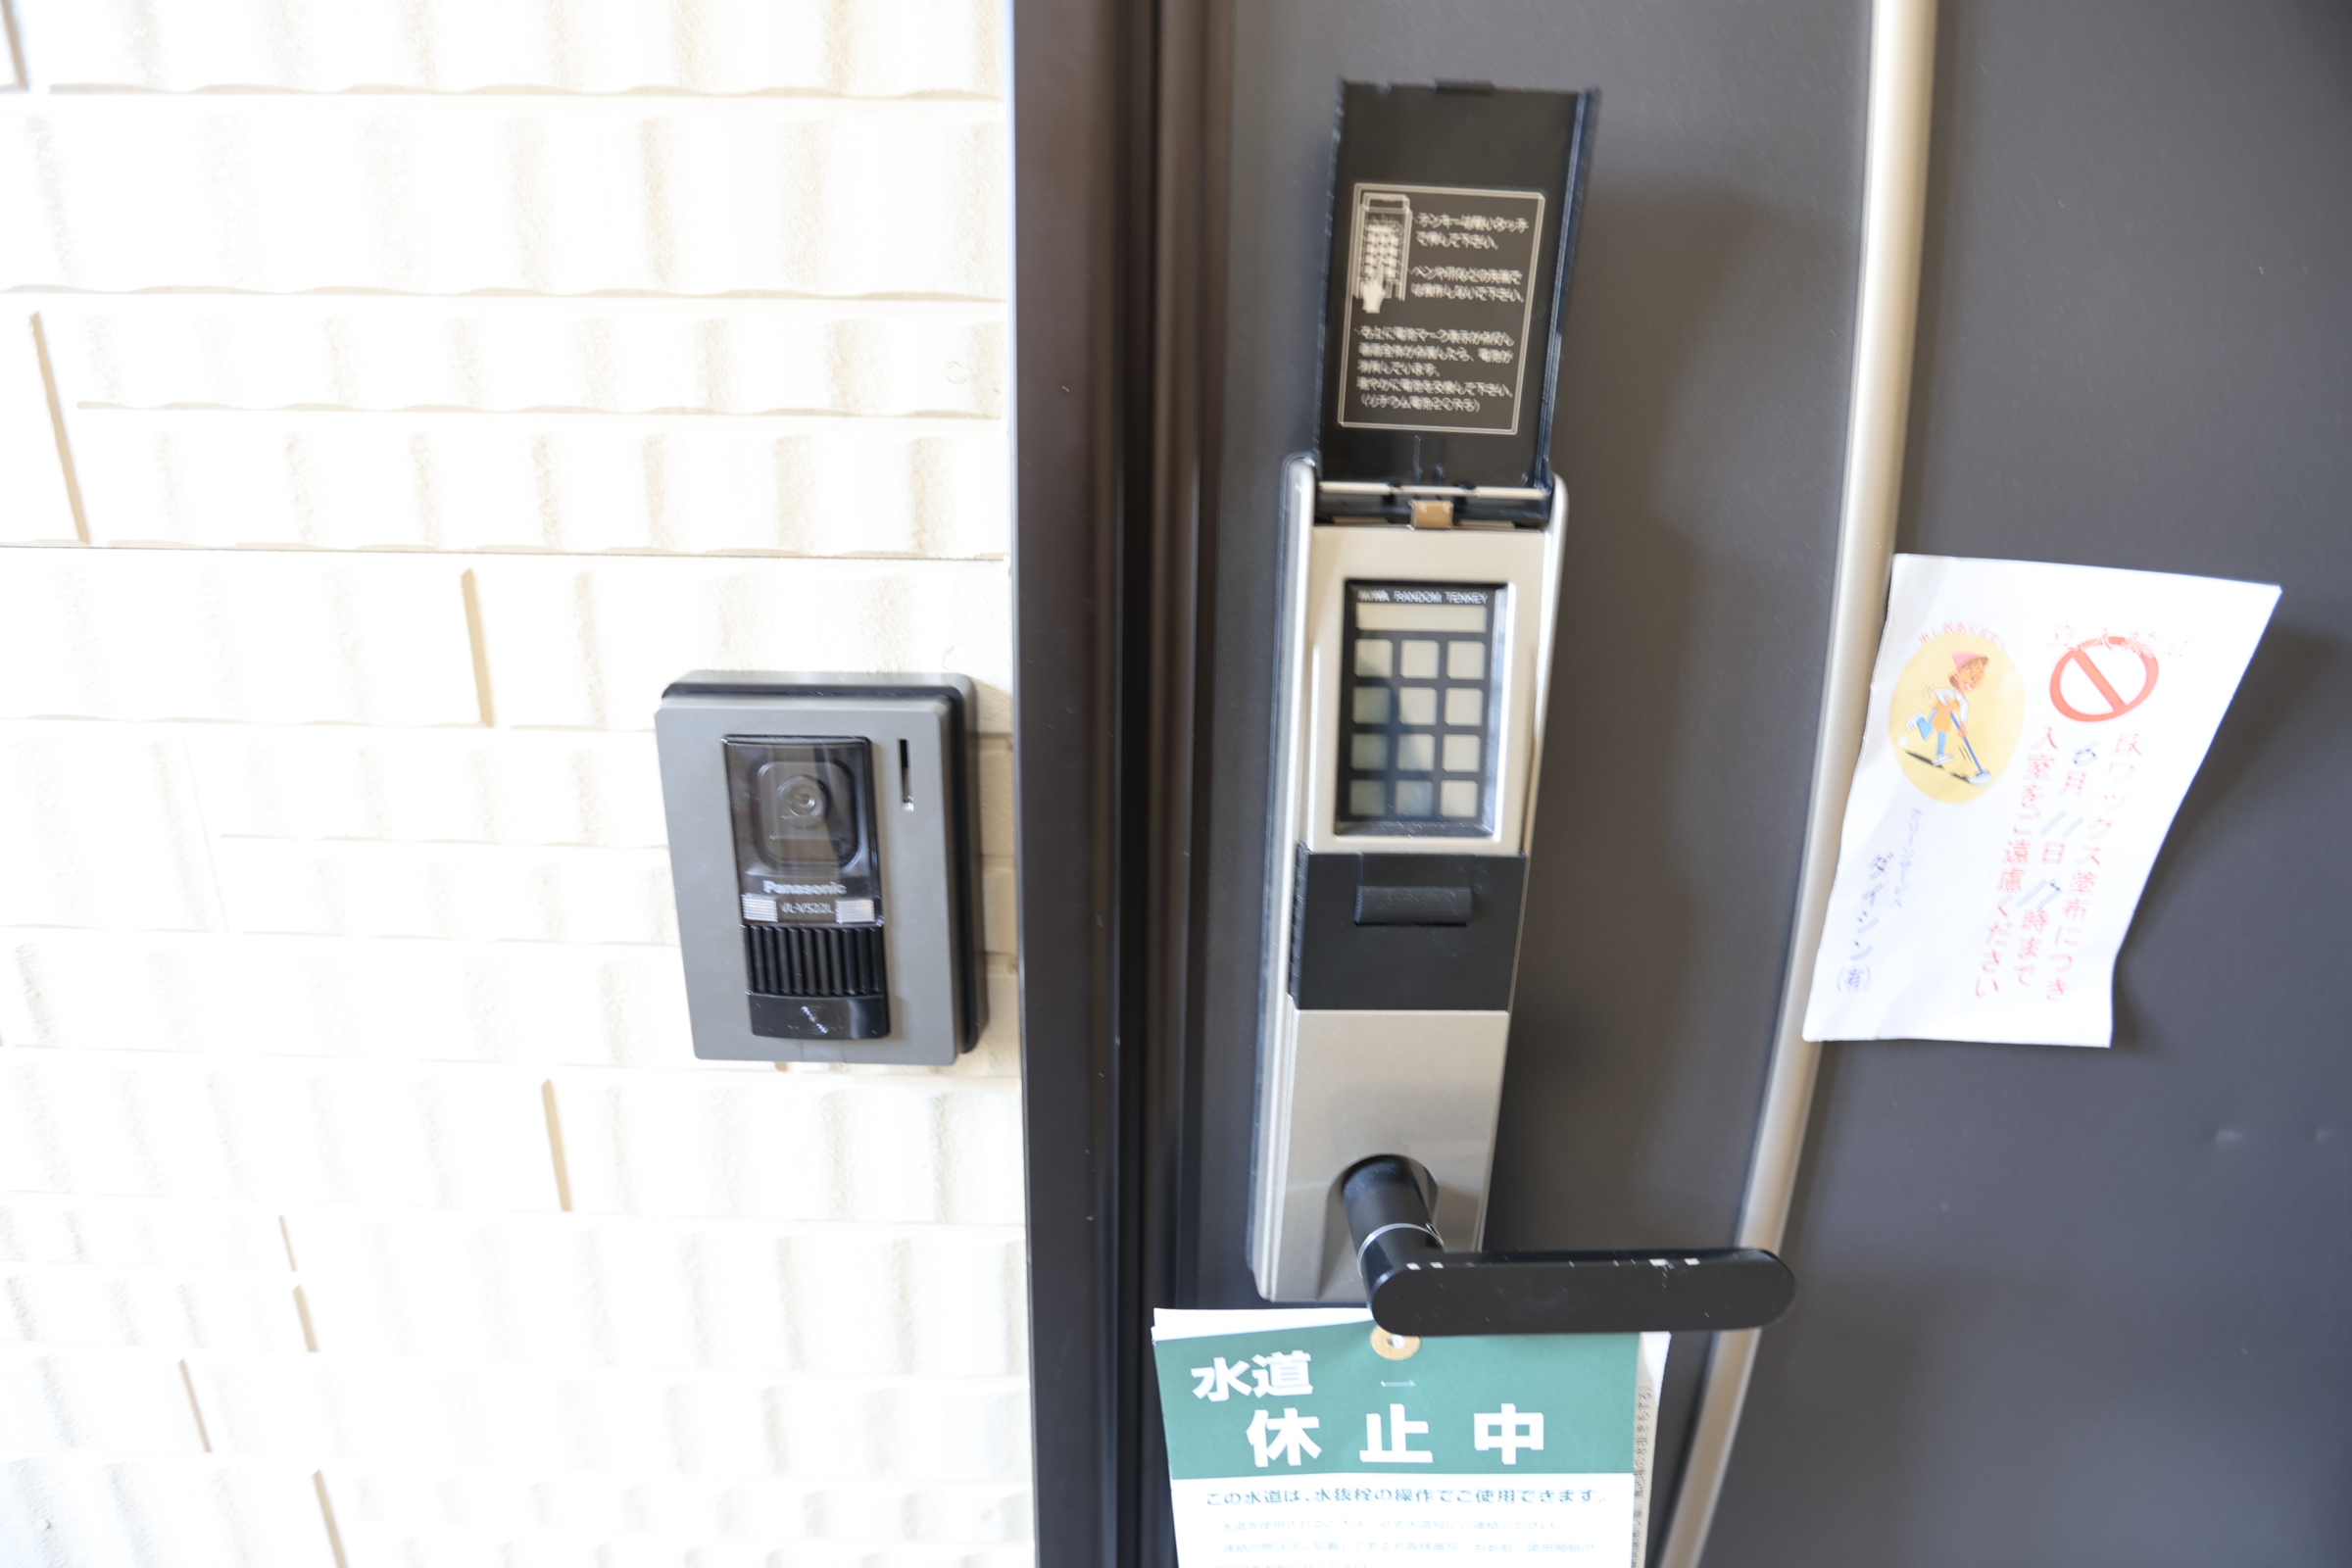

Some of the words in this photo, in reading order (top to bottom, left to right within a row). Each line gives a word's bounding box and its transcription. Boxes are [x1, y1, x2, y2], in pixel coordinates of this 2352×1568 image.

[1357, 589, 1390, 602] MIWA
[1394, 590, 1442, 603] RANDOM
[1445, 591, 1488, 604] TENKEY
[762, 879, 847, 895] Panasonic
[1975, 723, 2059, 999] 入室をご遠慮ください
[2046, 731, 2144, 1002] 床ワックス塗布につき
[1190, 1349, 1314, 1402] 水道
[1245, 1402, 1544, 1468] 休止中
